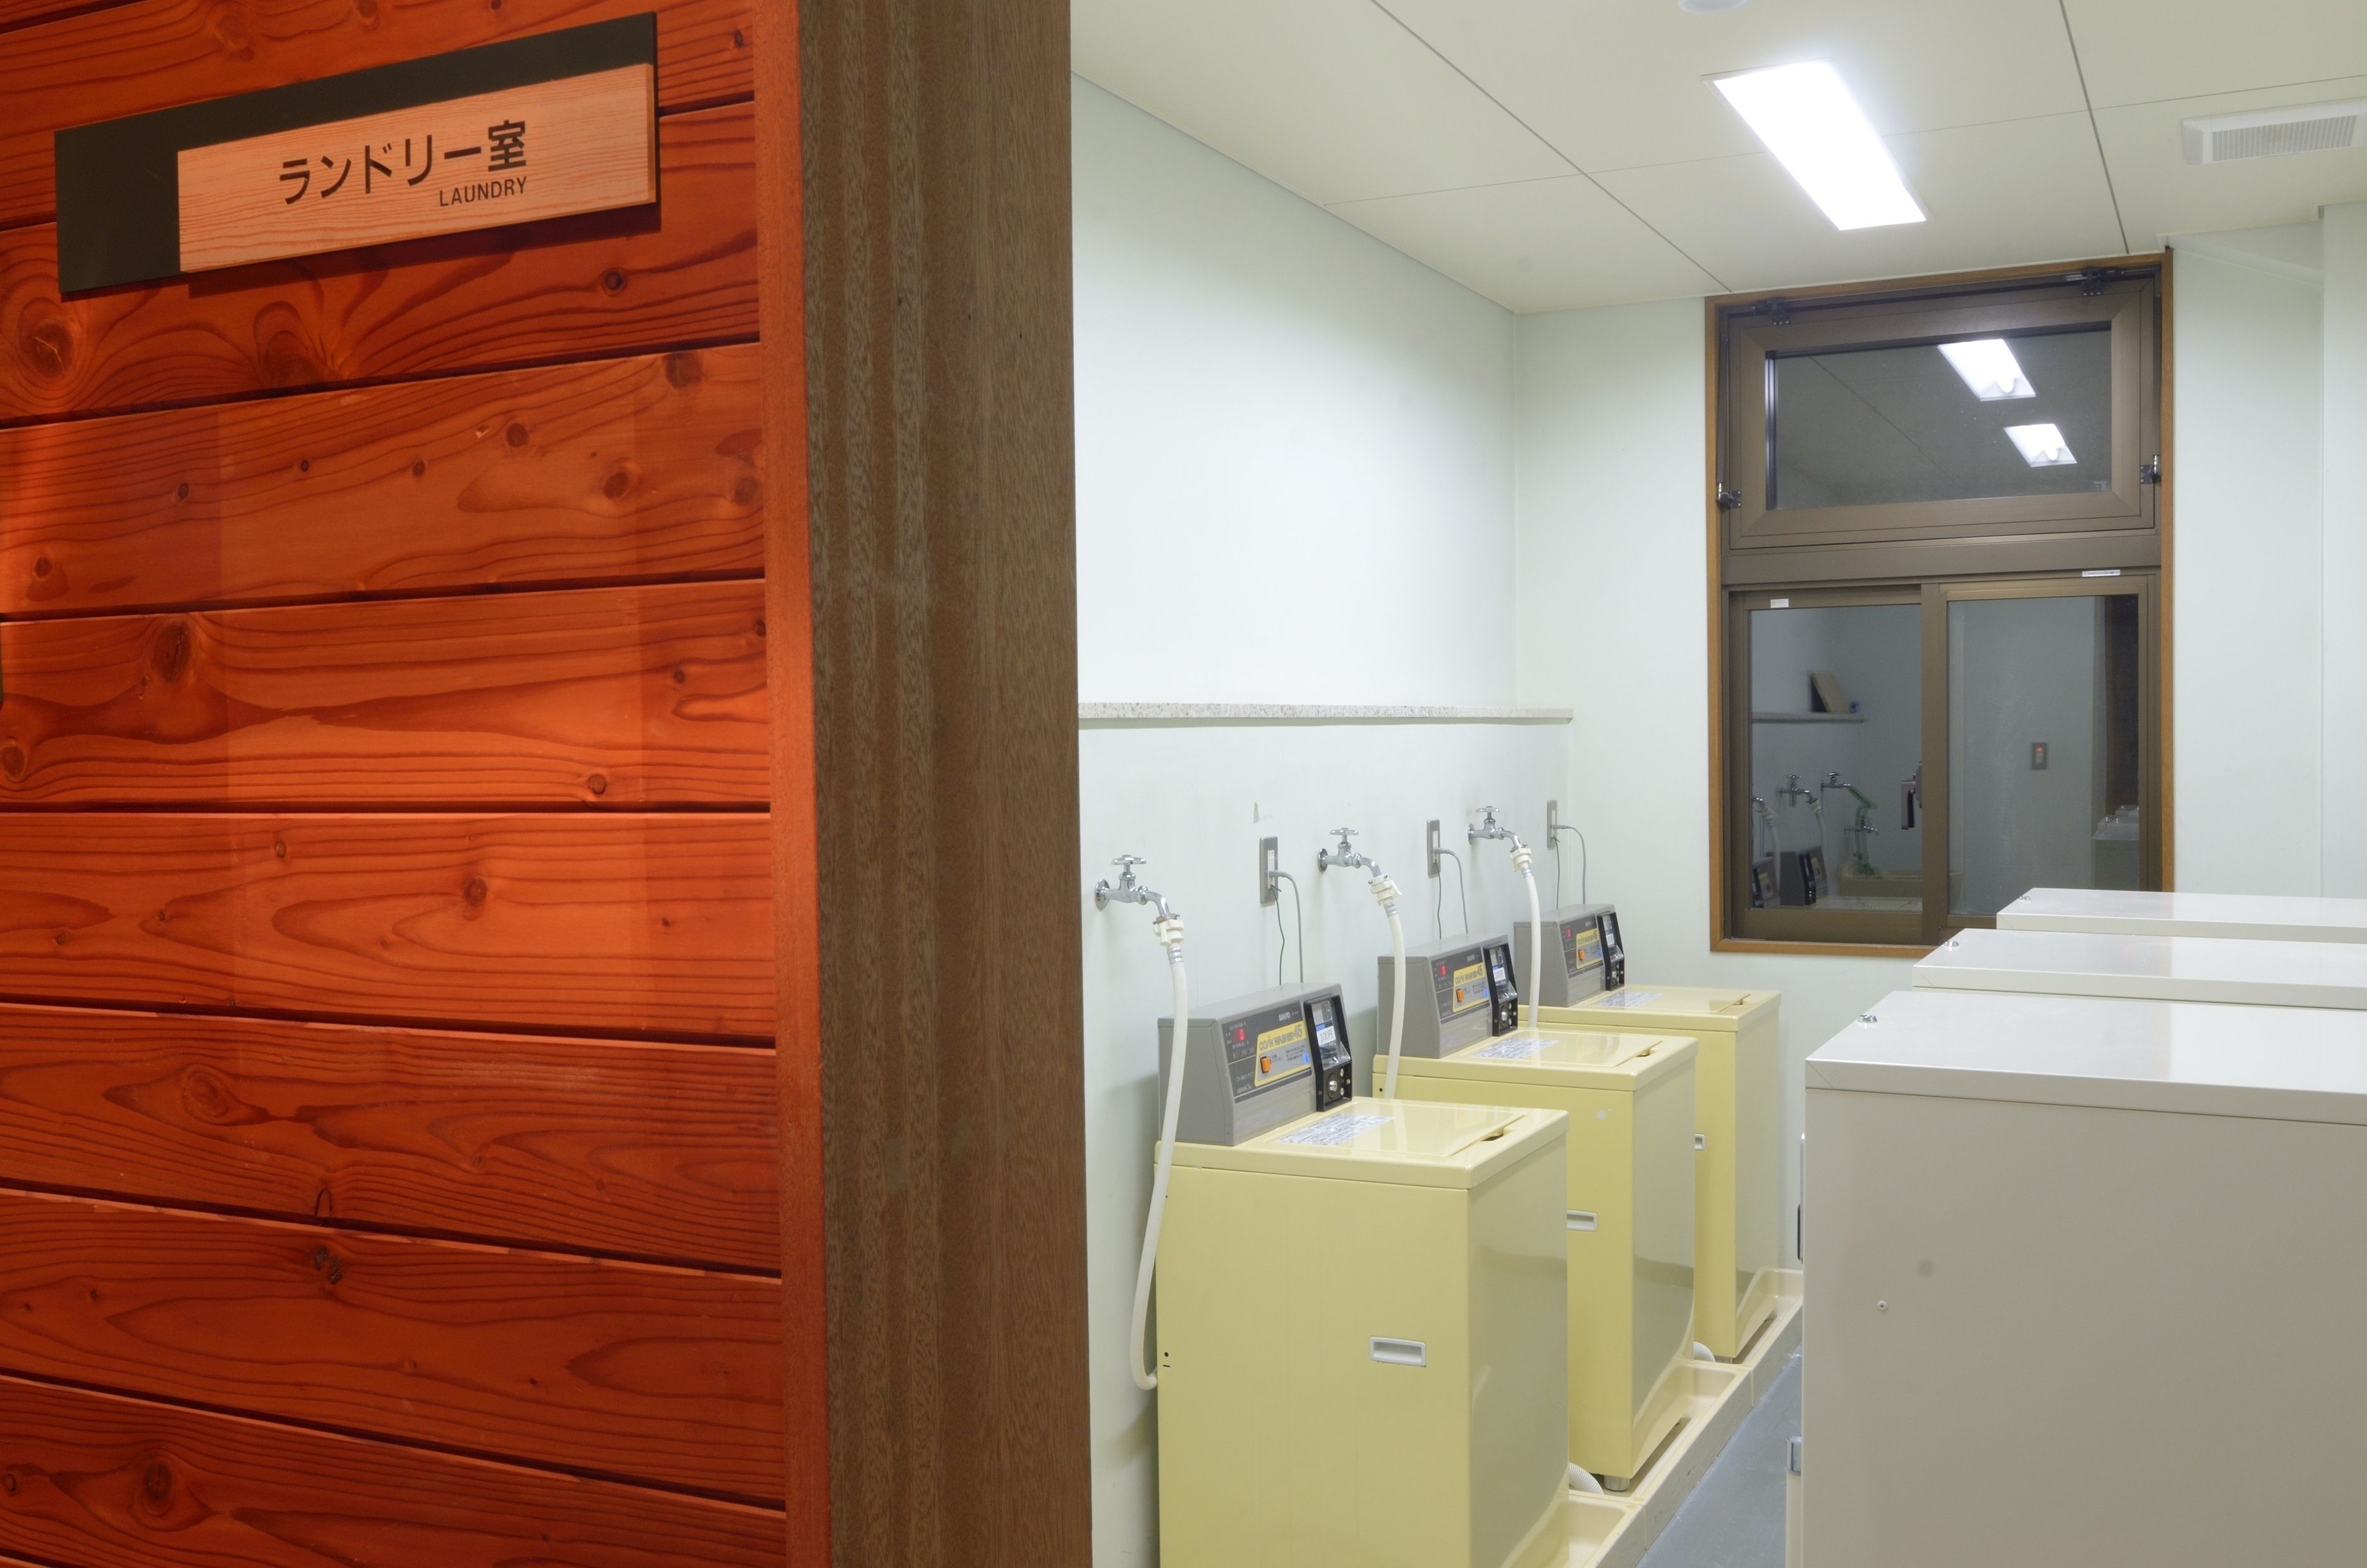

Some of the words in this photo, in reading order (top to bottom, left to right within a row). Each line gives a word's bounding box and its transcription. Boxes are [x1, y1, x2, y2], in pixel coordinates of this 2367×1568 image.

[279, 119, 526, 205] ランドリー室
[440, 176, 526, 207] LAUNDRY
[1320, 1029, 1334, 1043] 100円
